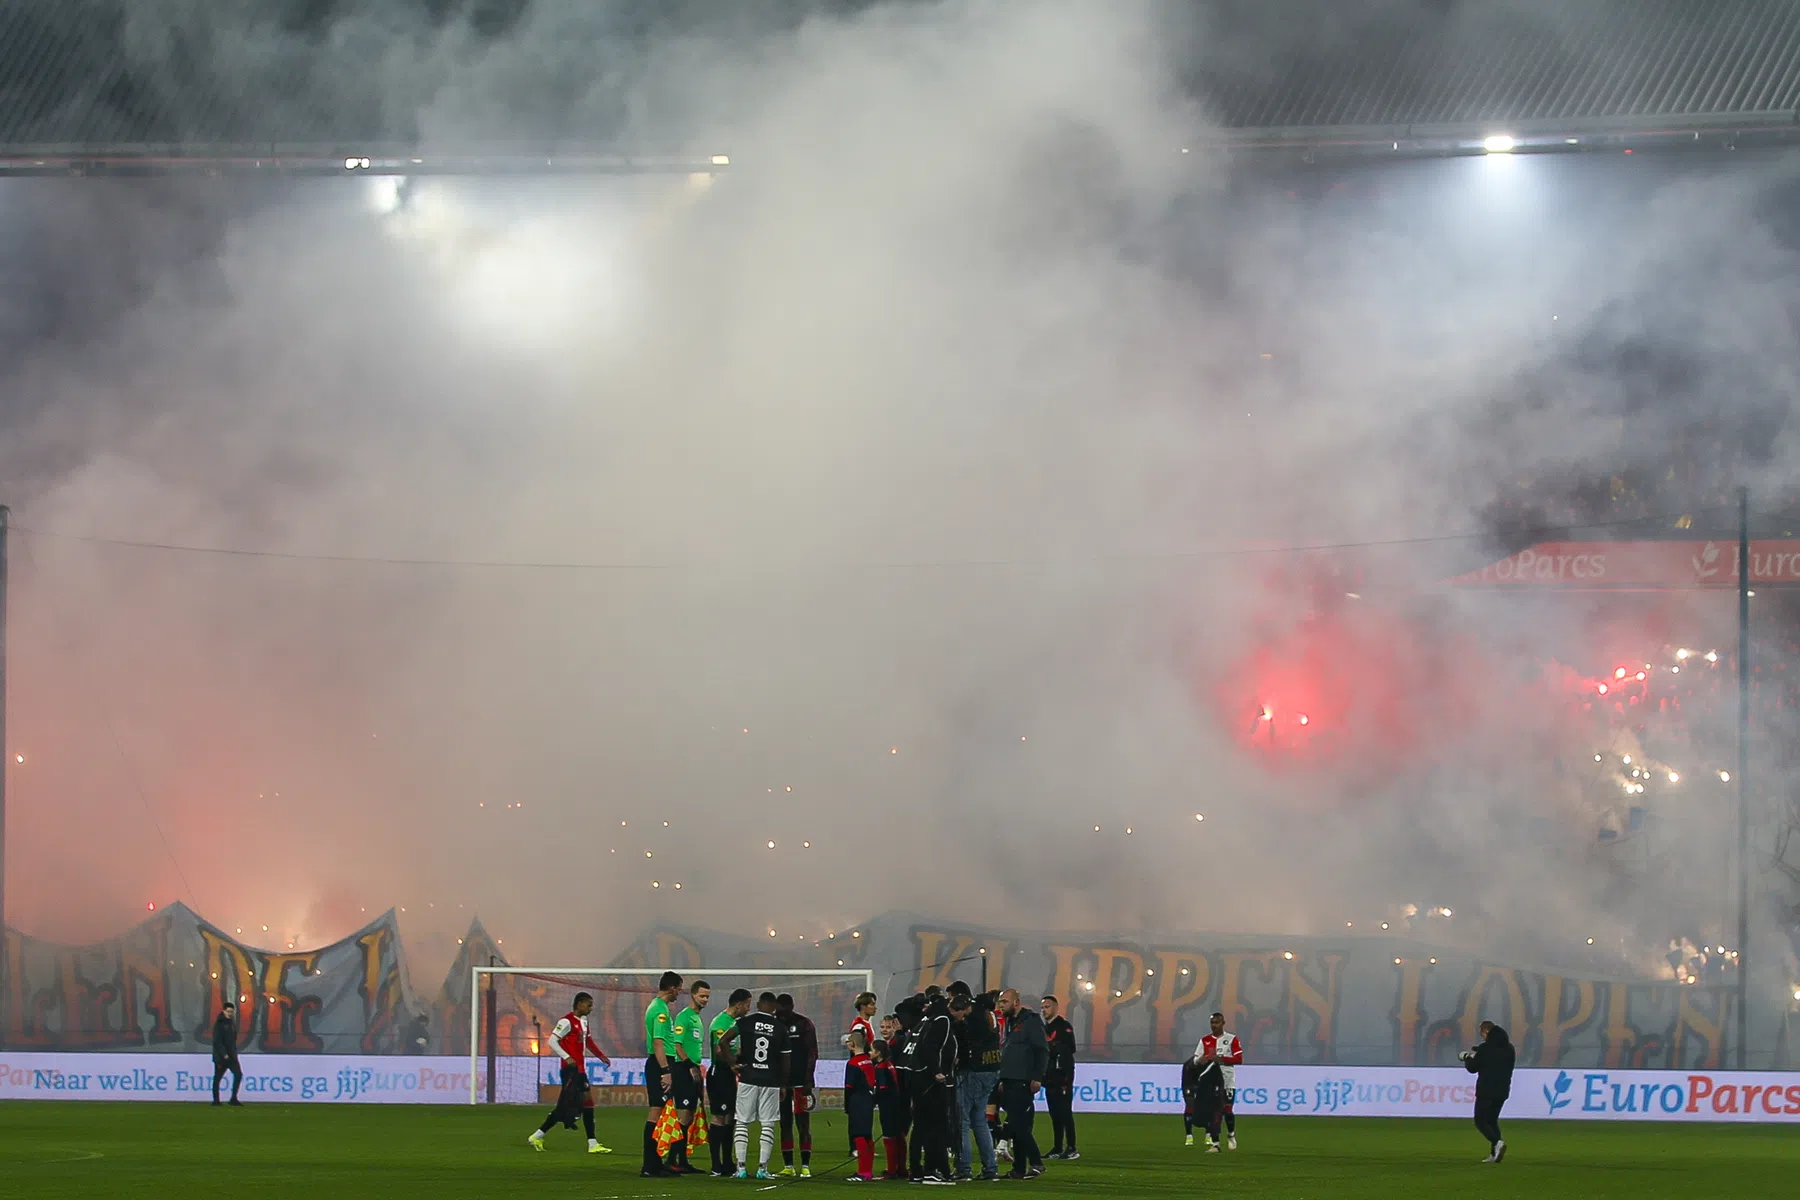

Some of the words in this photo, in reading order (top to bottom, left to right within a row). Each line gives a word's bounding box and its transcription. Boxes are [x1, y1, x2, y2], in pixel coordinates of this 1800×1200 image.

[754, 1036, 770, 1063] 8
[34, 1069, 92, 1090] Naar
[98, 1069, 168, 1091] welke
[176, 1071, 294, 1093] Euroarcs
[301, 1076, 328, 1098] ga
[333, 1070, 371, 1099] jij?
[1277, 1088, 1307, 1111] ga
[1312, 1079, 1353, 1112] jij?
[1582, 1074, 1800, 1114] EuroParcs
